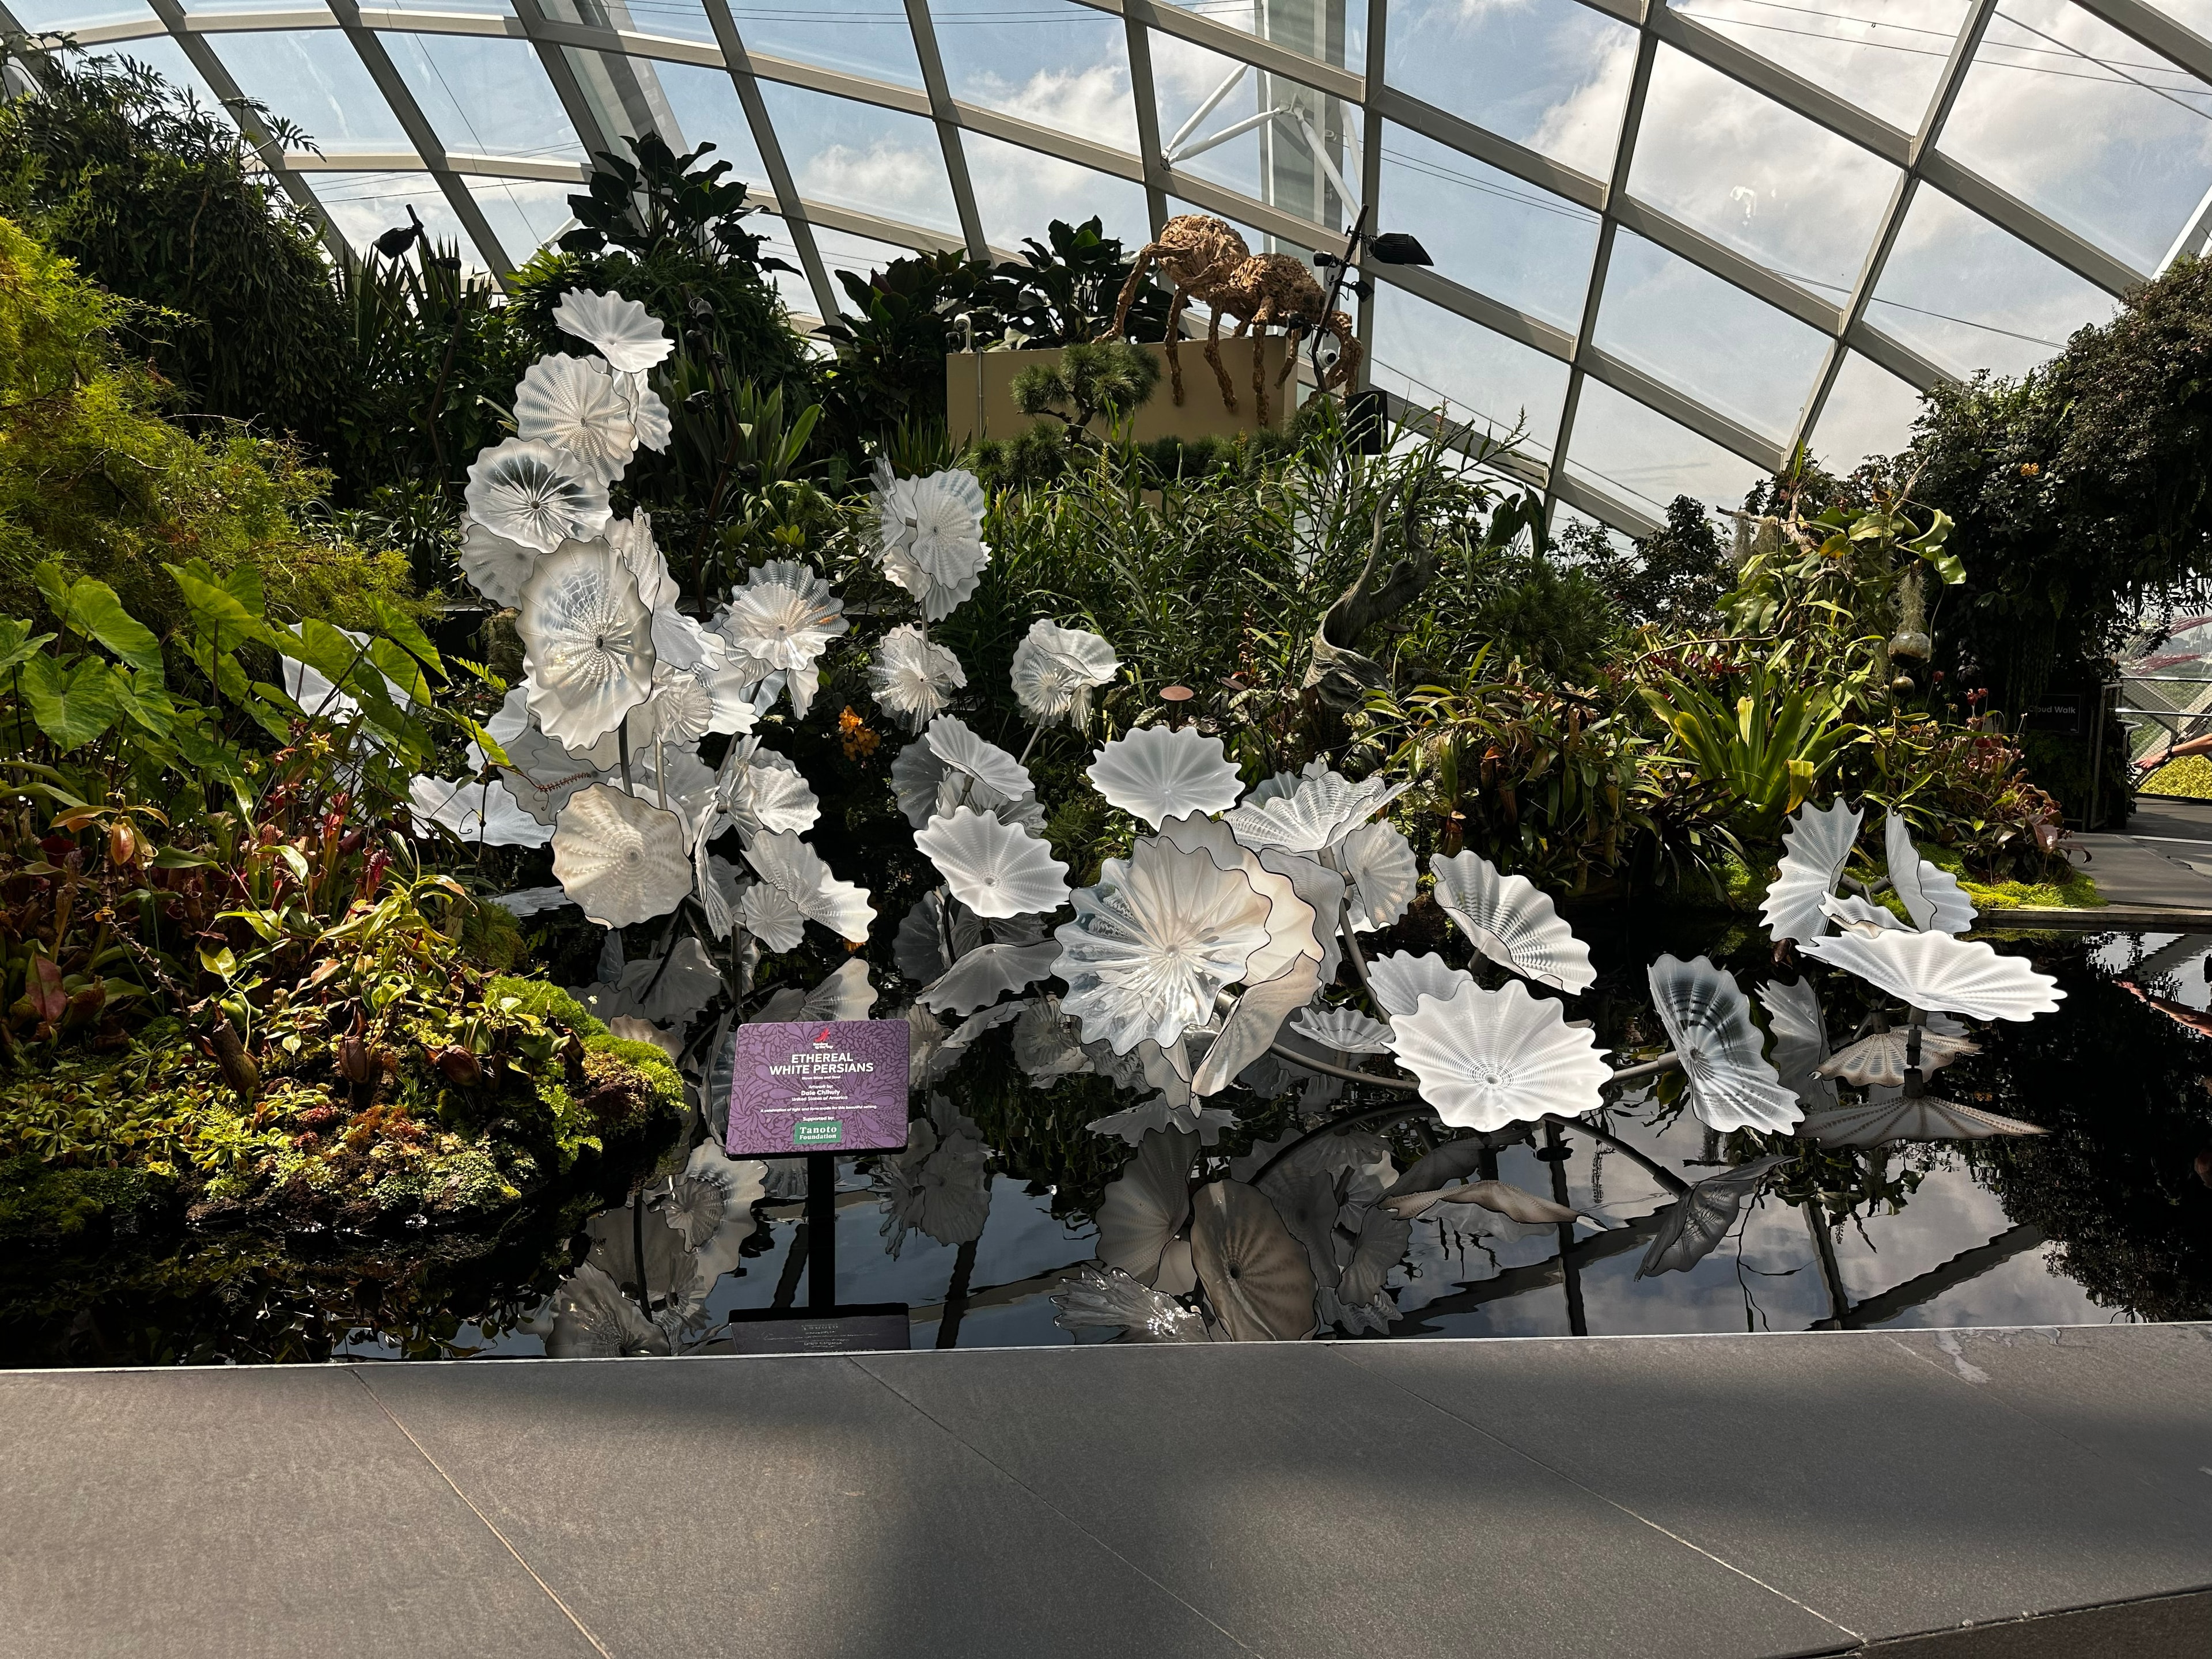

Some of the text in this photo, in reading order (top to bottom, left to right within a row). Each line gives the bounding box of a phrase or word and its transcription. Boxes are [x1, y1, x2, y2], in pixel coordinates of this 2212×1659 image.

[2054, 706, 2076, 714] Walk
[791, 1052, 854, 1063] ETHEREAL
[769, 1063, 874, 1075] WHITE PERSIANS
[800, 1126, 837, 1134] Tanoto
